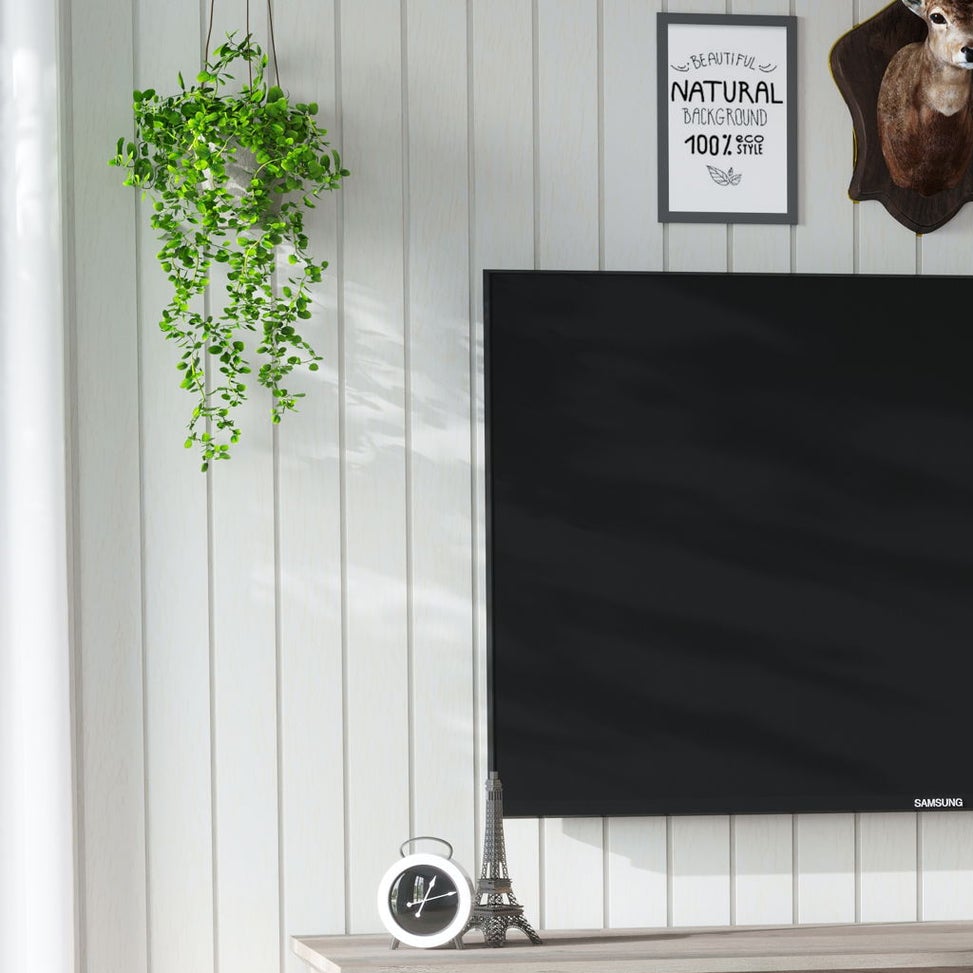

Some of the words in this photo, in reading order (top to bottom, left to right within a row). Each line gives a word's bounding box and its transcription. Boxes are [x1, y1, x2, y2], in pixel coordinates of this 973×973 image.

[690, 52, 755, 70] BEAUTIFUL
[671, 80, 783, 104] NATURAL
[682, 107, 768, 126] BACKGROUND
[684, 134, 732, 156] 100%
[737, 144, 763, 155] STYLE
[914, 798, 963, 807] SAMSUNG
